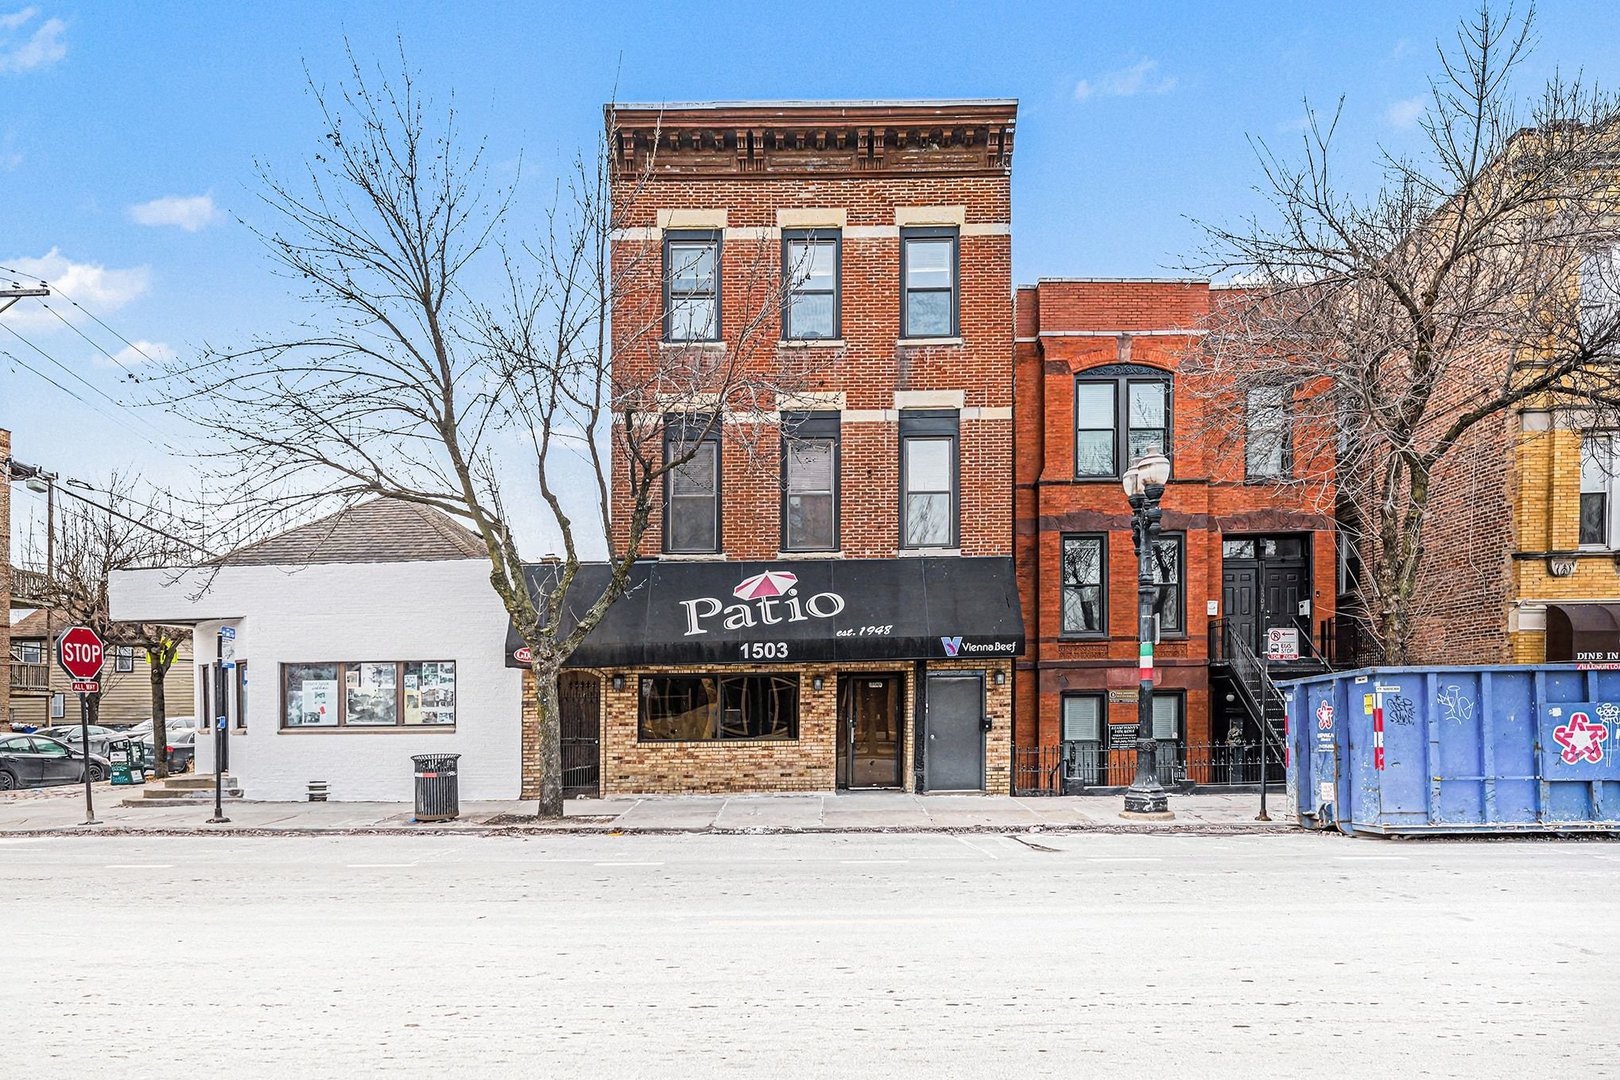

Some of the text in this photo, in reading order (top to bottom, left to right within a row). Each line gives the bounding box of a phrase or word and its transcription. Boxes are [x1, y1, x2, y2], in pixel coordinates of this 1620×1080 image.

[679, 588, 846, 637] Patio
[836, 624, 894, 637] est. 1948
[64, 643, 101, 663] STOP
[739, 642, 789, 660] 1503
[961, 641, 1017, 653] Vienna Beef
[1576, 652, 1619, 660] DINE IN
